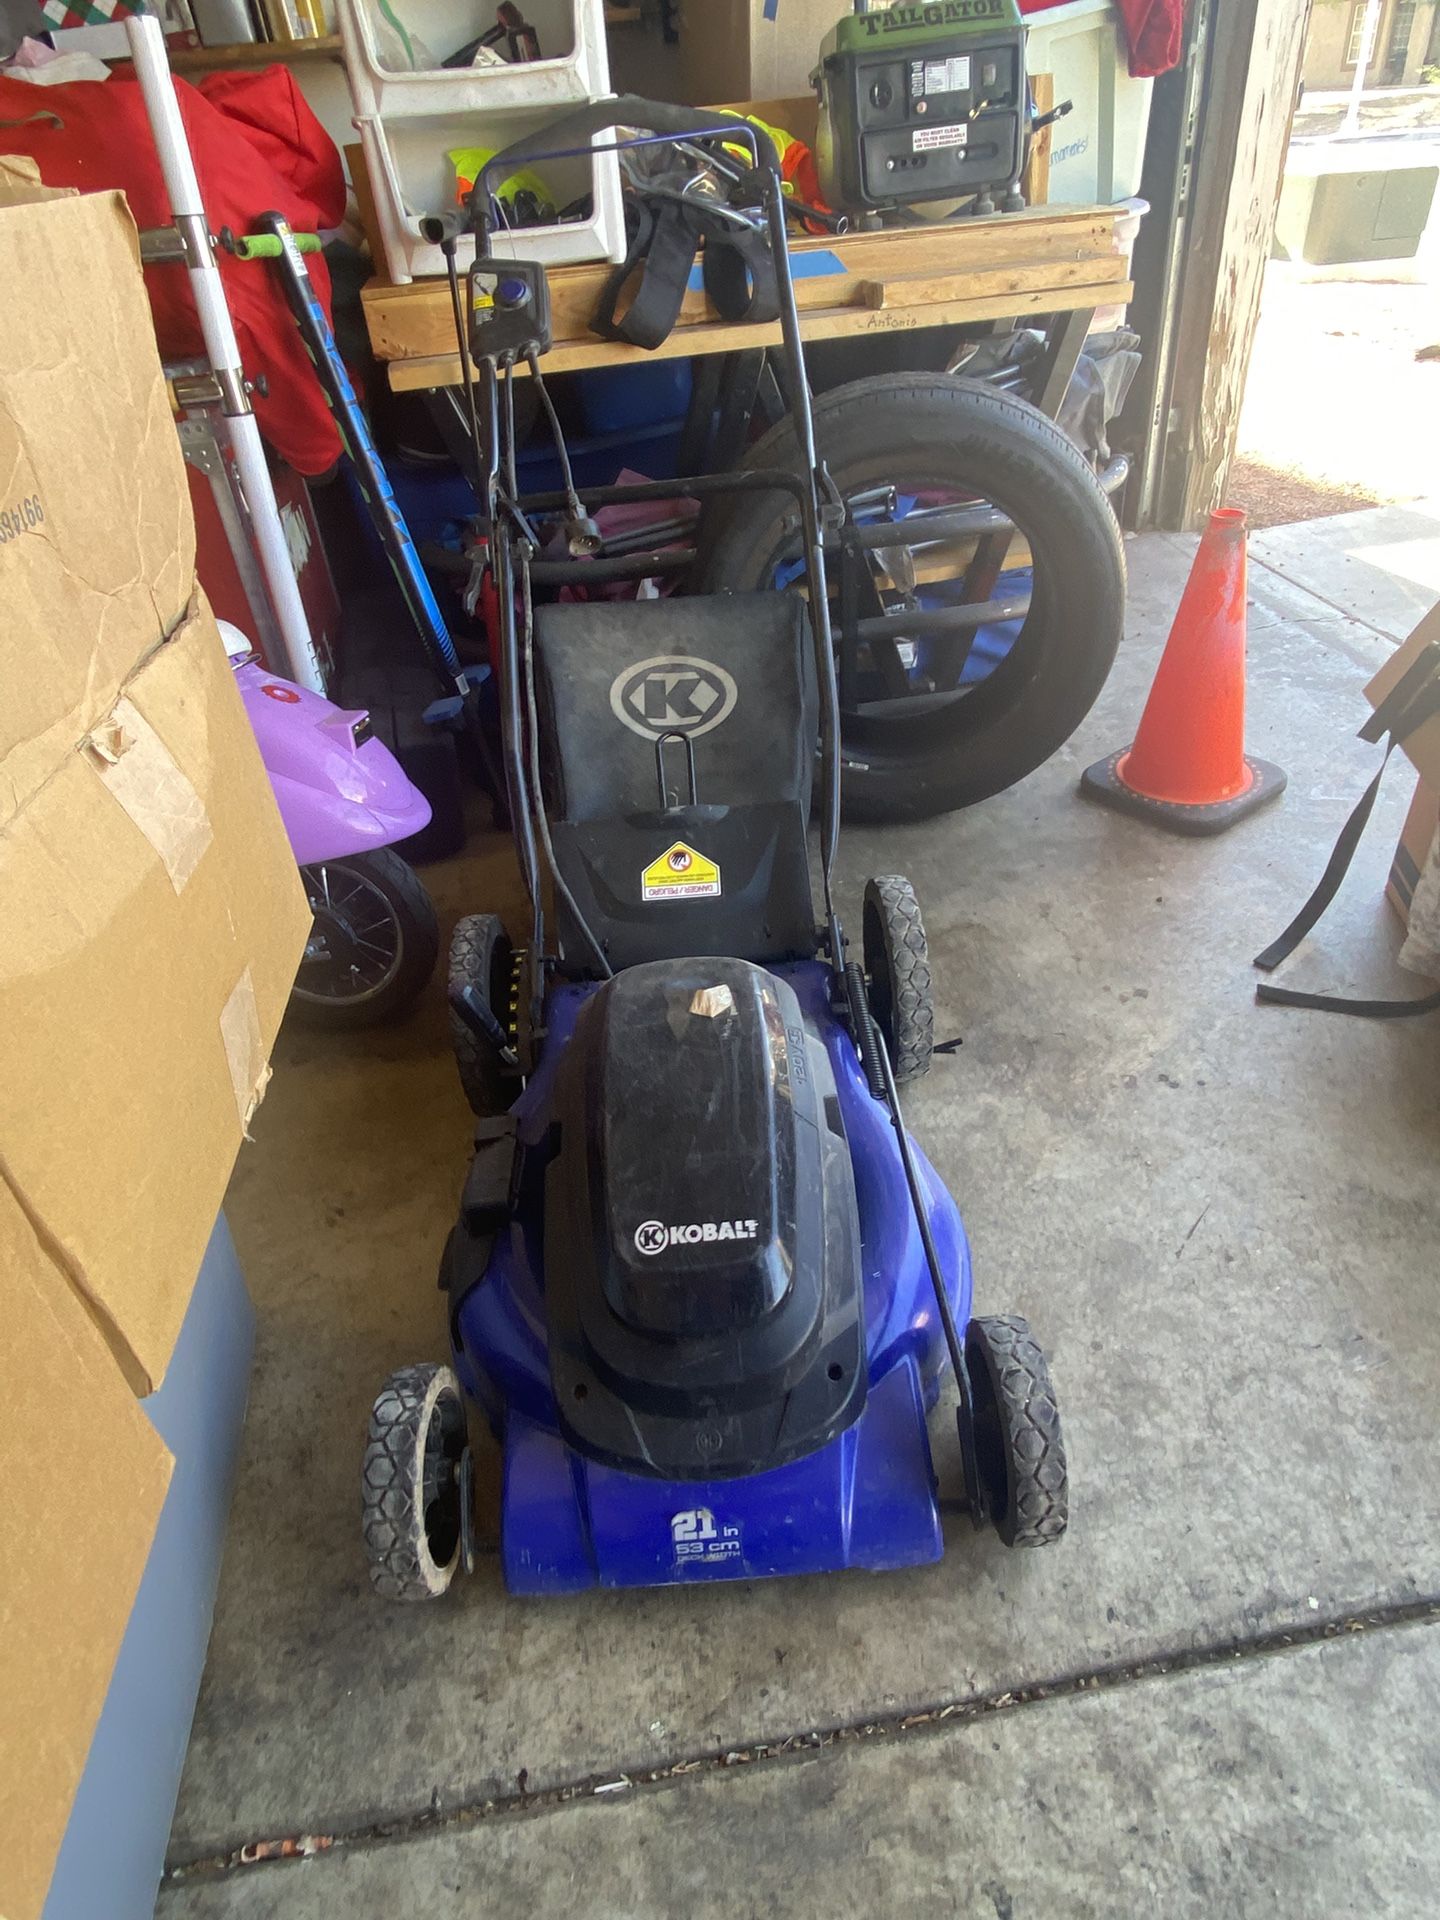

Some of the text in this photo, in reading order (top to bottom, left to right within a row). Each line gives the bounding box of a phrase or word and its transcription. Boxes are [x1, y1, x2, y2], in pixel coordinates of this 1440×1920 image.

[860, 0, 1004, 36] TAILGATOR
[648, 887, 679, 896] PELIGRO
[684, 885, 713, 893] DANGER
[670, 1219, 759, 1245] KOBALT
[671, 1507, 738, 1541] 21 in
[675, 1541, 740, 1554] 53 cm
